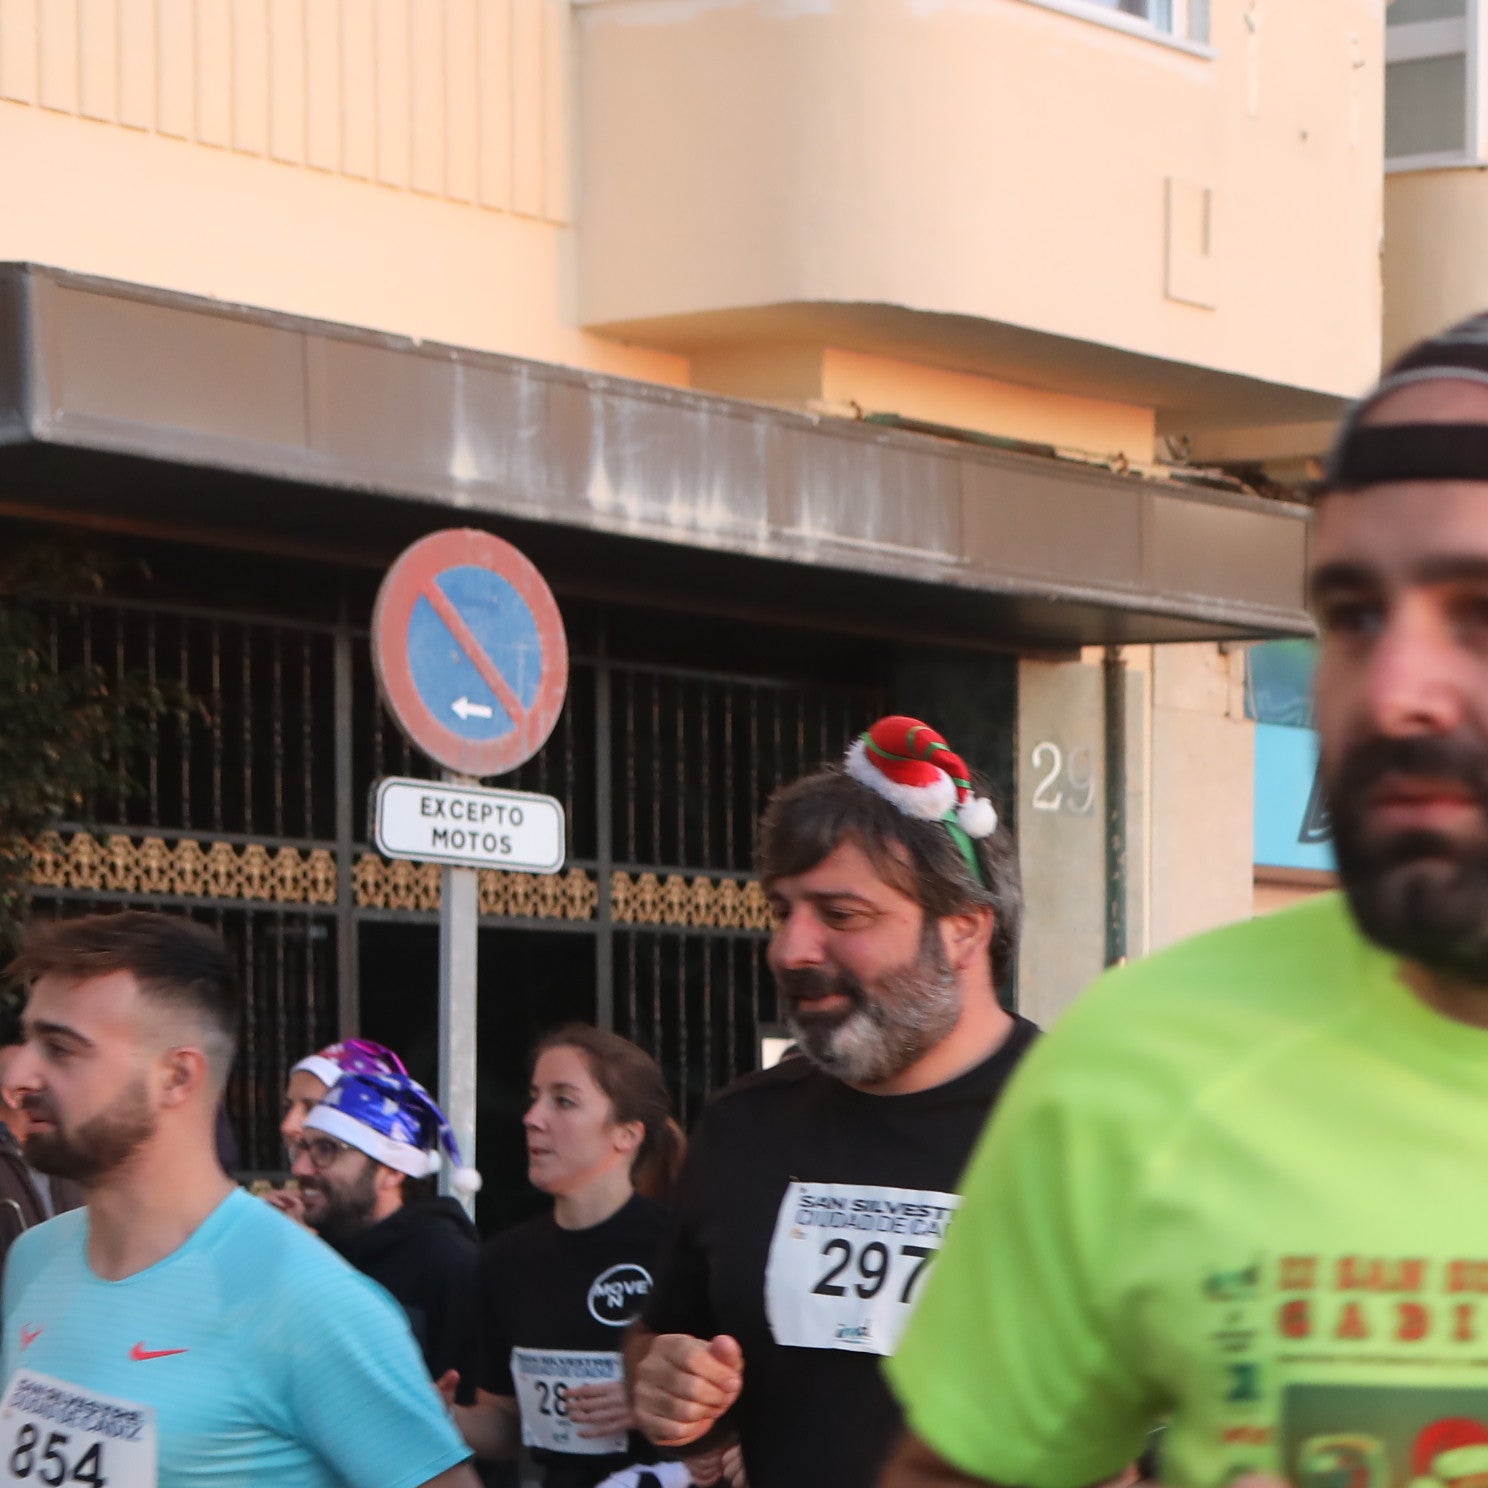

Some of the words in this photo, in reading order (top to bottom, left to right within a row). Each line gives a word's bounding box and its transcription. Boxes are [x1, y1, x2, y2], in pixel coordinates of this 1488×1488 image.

[1031, 741, 1095, 815] 29
[420, 796, 525, 827] EXCEPTO
[432, 827, 513, 855] MOTOS
[799, 1194, 845, 1210] SAN
[850, 1198, 956, 1220] SILVEST
[795, 1209, 875, 1230] CIUDAD
[876, 1214, 907, 1234] DE
[910, 1218, 943, 1238] CA
[810, 1238, 940, 1304] 297
[595, 1282, 648, 1297] MOVE
[534, 1379, 570, 1417] 28
